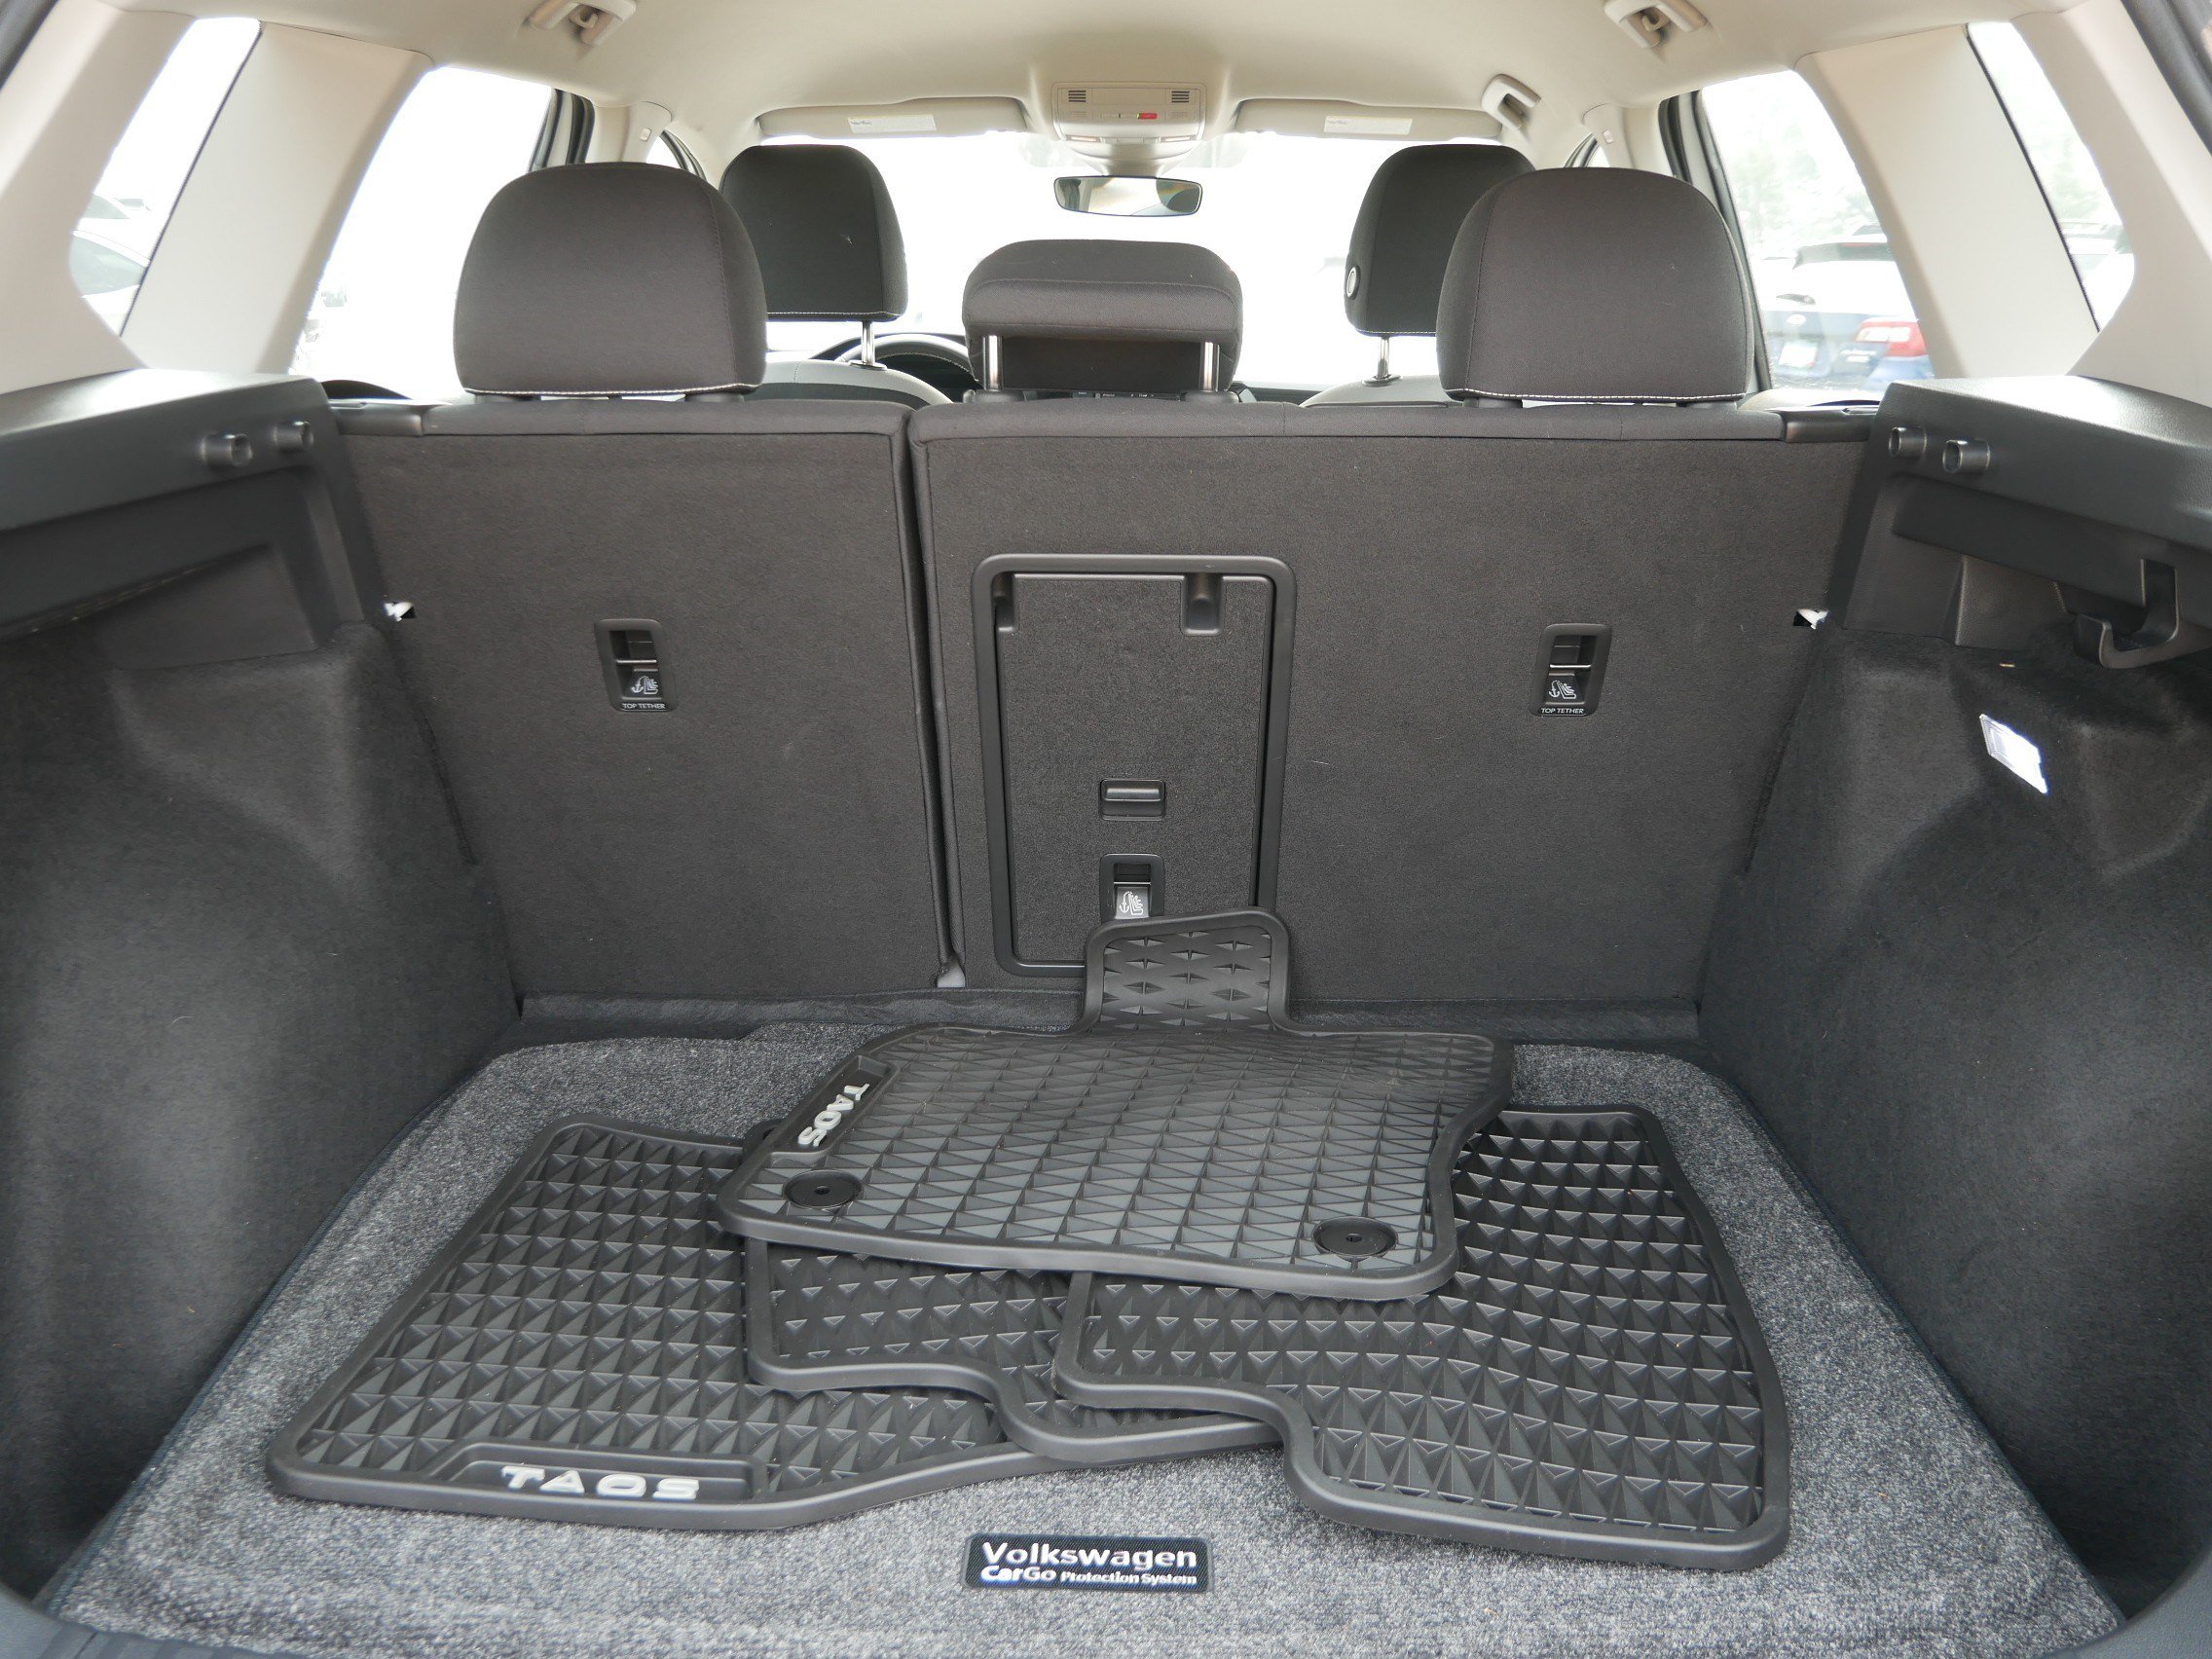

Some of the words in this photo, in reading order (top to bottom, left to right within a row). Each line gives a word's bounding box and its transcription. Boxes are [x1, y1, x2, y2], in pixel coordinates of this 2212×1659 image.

[798, 1084, 869, 1147] TAOS
[501, 1465, 699, 1500] TAOS
[982, 1541, 1198, 1571] Volkswagen
[980, 1565, 1057, 1583] CarGo
[1060, 1570, 1140, 1584] Protection
[1141, 1572, 1198, 1586] System
